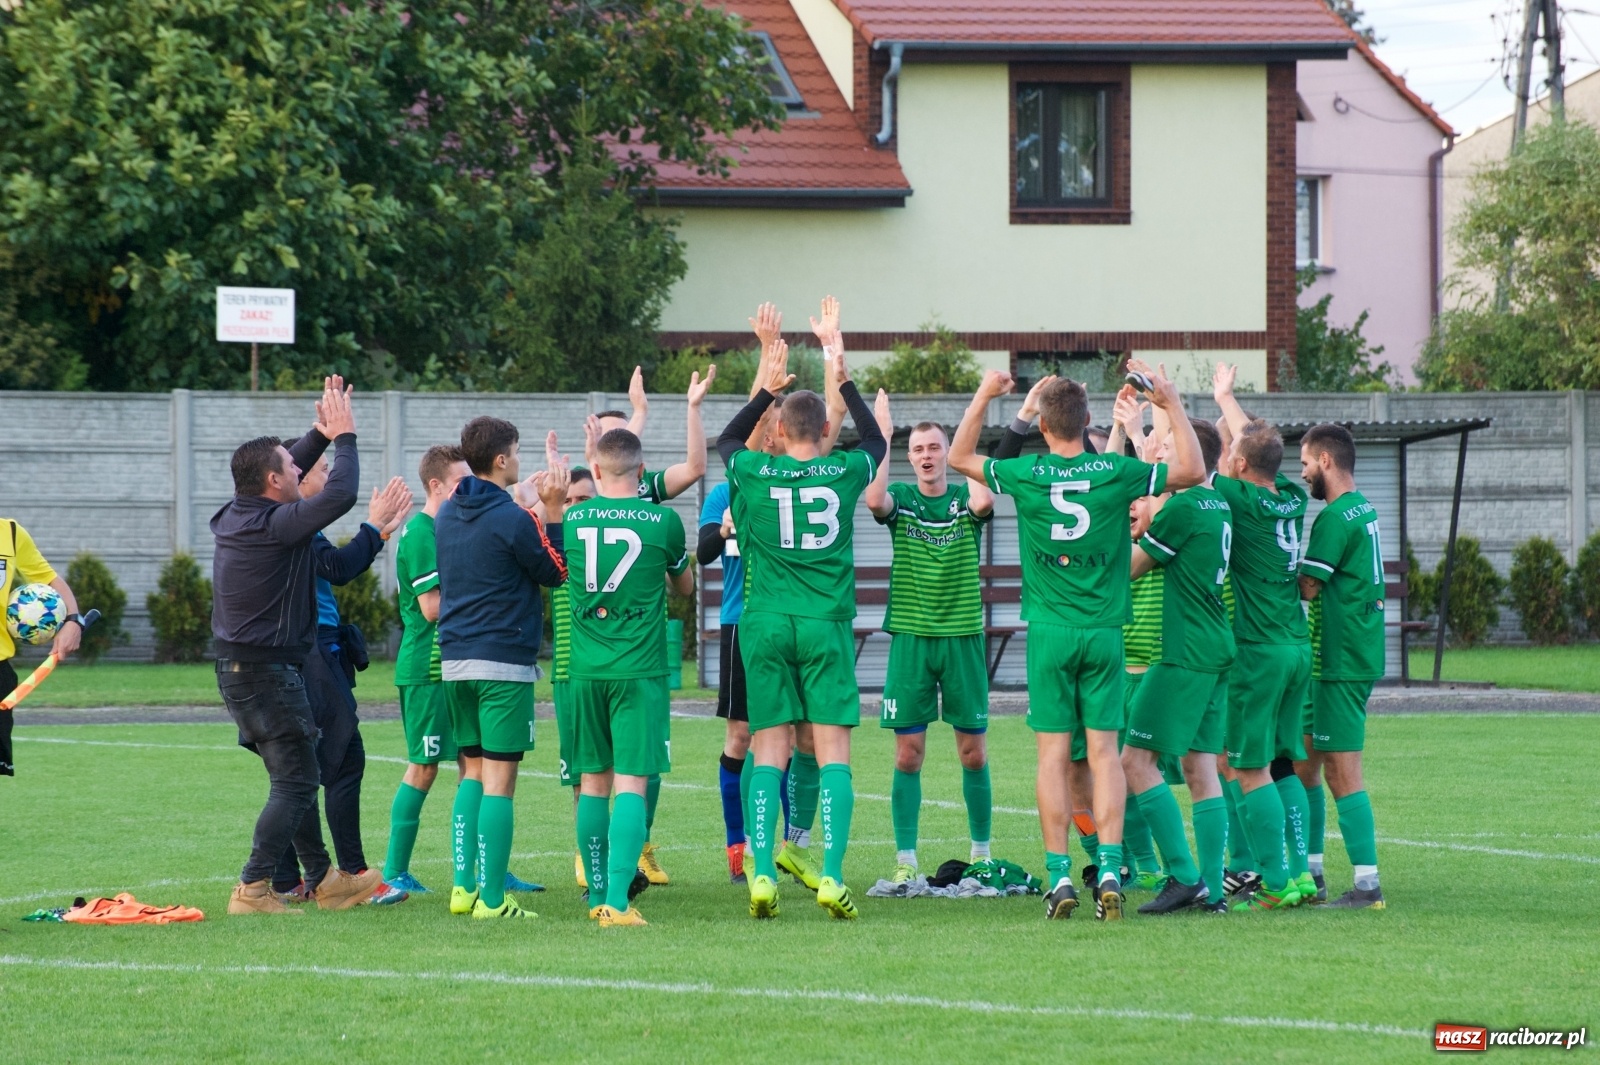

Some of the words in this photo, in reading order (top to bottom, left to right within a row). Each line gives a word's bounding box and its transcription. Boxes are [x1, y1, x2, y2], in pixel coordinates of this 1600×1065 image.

[567, 509, 585, 521] LKS
[588, 507, 662, 522] TWORKÓW
[1050, 480, 1091, 541] 5
[1198, 499, 1216, 510] LKS
[1343, 507, 1361, 521] LKS
[769, 486, 840, 550] 13
[1276, 518, 1300, 572] 4
[576, 527, 643, 593] 17
[883, 698, 897, 720] 14
[423, 735, 440, 757] 15
